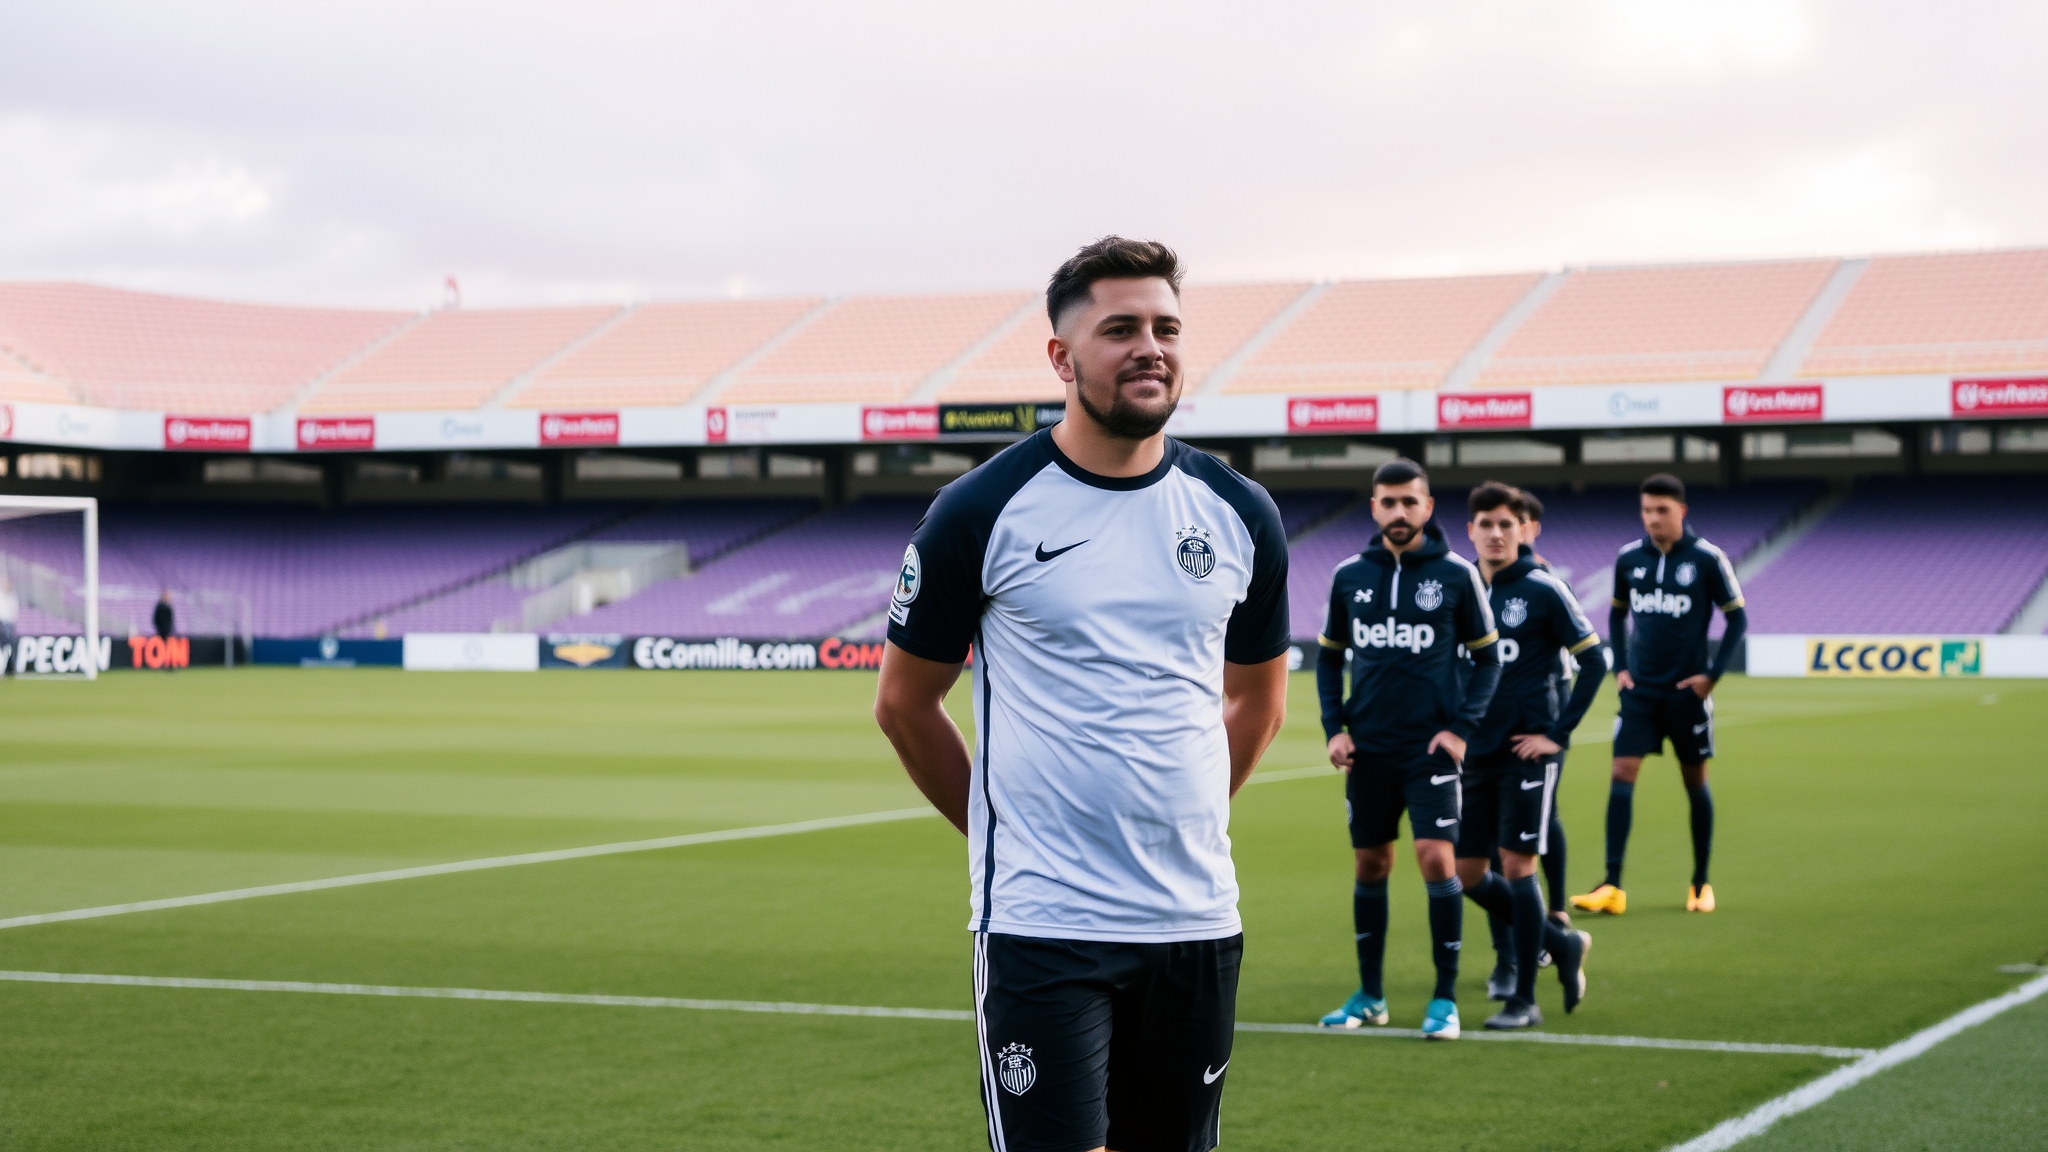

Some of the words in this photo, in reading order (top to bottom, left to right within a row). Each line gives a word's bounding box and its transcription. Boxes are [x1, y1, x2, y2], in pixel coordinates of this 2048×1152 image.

[1629, 588, 1692, 618] belap
[1353, 616, 1435, 654] belap
[1811, 642, 1933, 671] LCCOC
